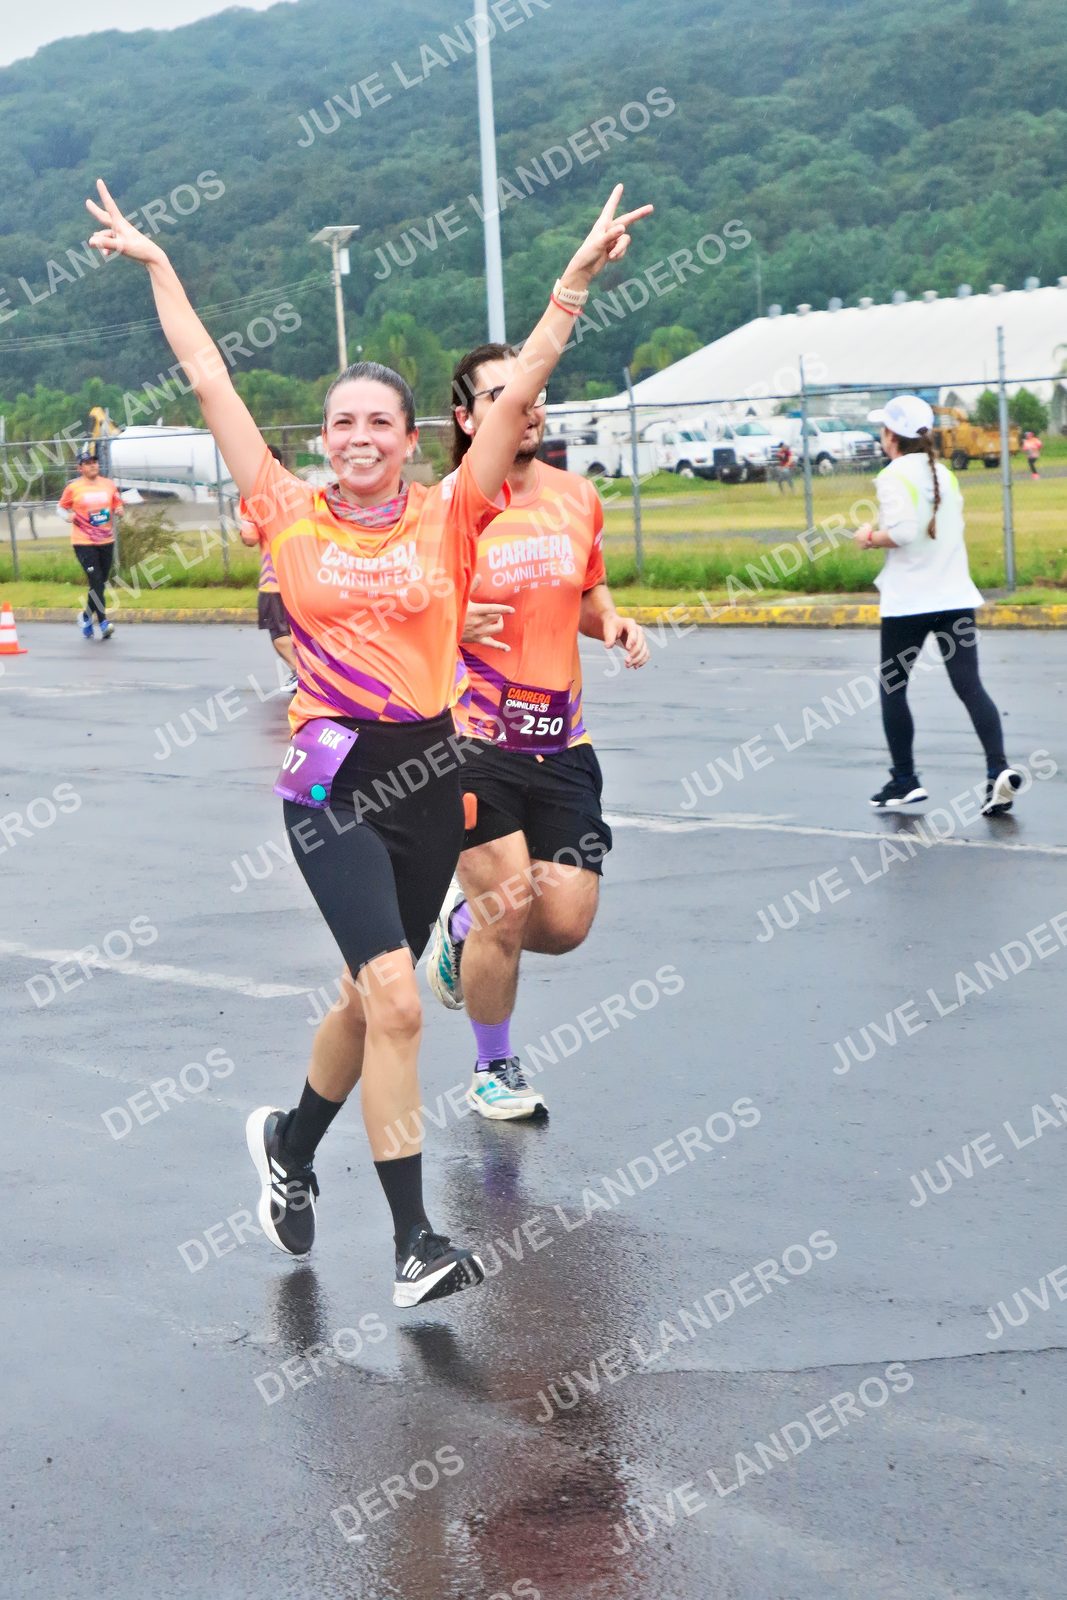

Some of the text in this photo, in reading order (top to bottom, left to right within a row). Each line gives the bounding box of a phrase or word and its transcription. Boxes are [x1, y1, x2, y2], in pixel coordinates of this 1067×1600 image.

[487, 534, 573, 570] CARRERA
[507, 687, 552, 704] CARRERA
[520, 715, 564, 735] 250
